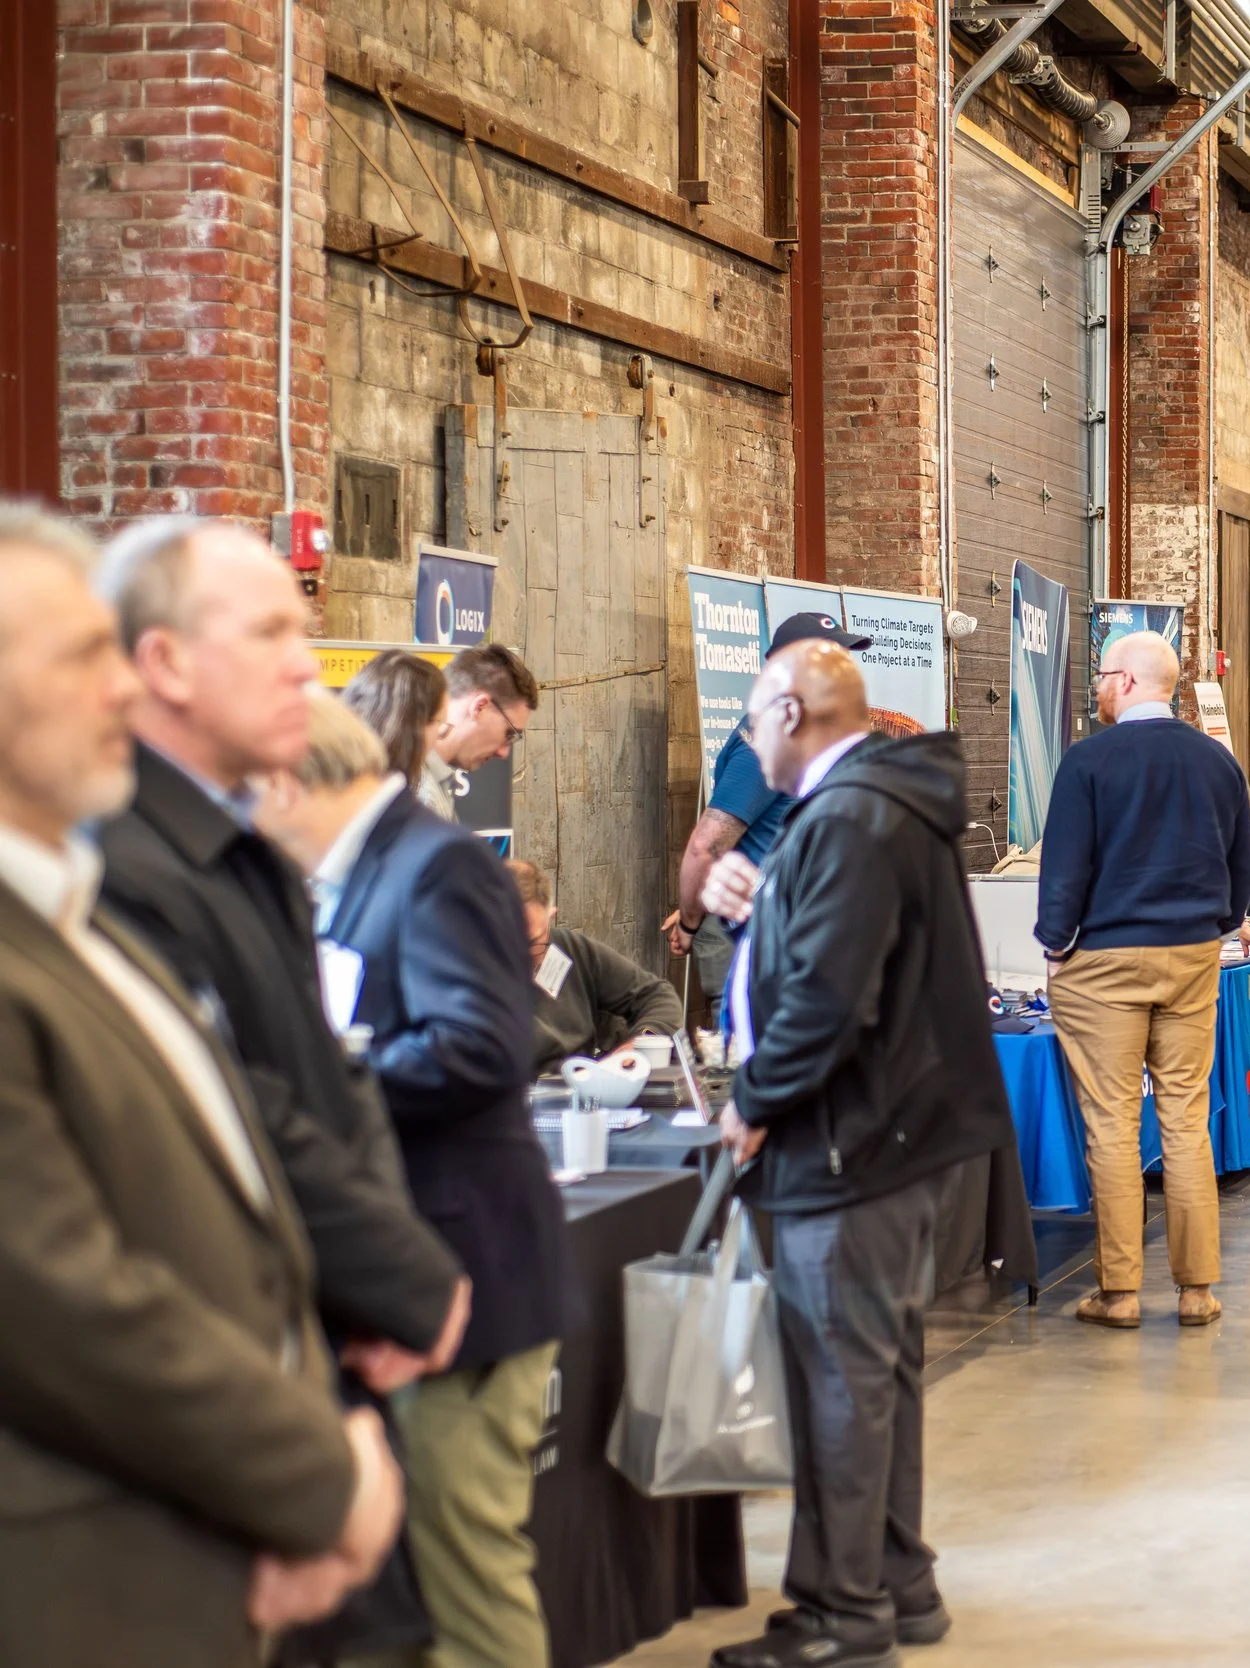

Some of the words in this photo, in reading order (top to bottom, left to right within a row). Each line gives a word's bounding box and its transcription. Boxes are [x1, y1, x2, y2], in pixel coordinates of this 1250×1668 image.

[455, 608, 486, 633] LOGIX
[694, 591, 760, 637] Thornton
[851, 614, 880, 632] Turning
[880, 617, 907, 632] Climate
[908, 620, 934, 636] Targets
[1098, 611, 1134, 624] SIEMENS
[1021, 600, 1048, 656] SIEMENS
[695, 632, 761, 675] Tomasetti
[869, 634, 899, 651] Building
[899, 637, 933, 652] Decisions,
[861, 651, 877, 664] One
[878, 653, 902, 668] Project
[903, 656, 911, 667] at
[911, 658, 917, 667] a
[917, 656, 933, 669] Time
